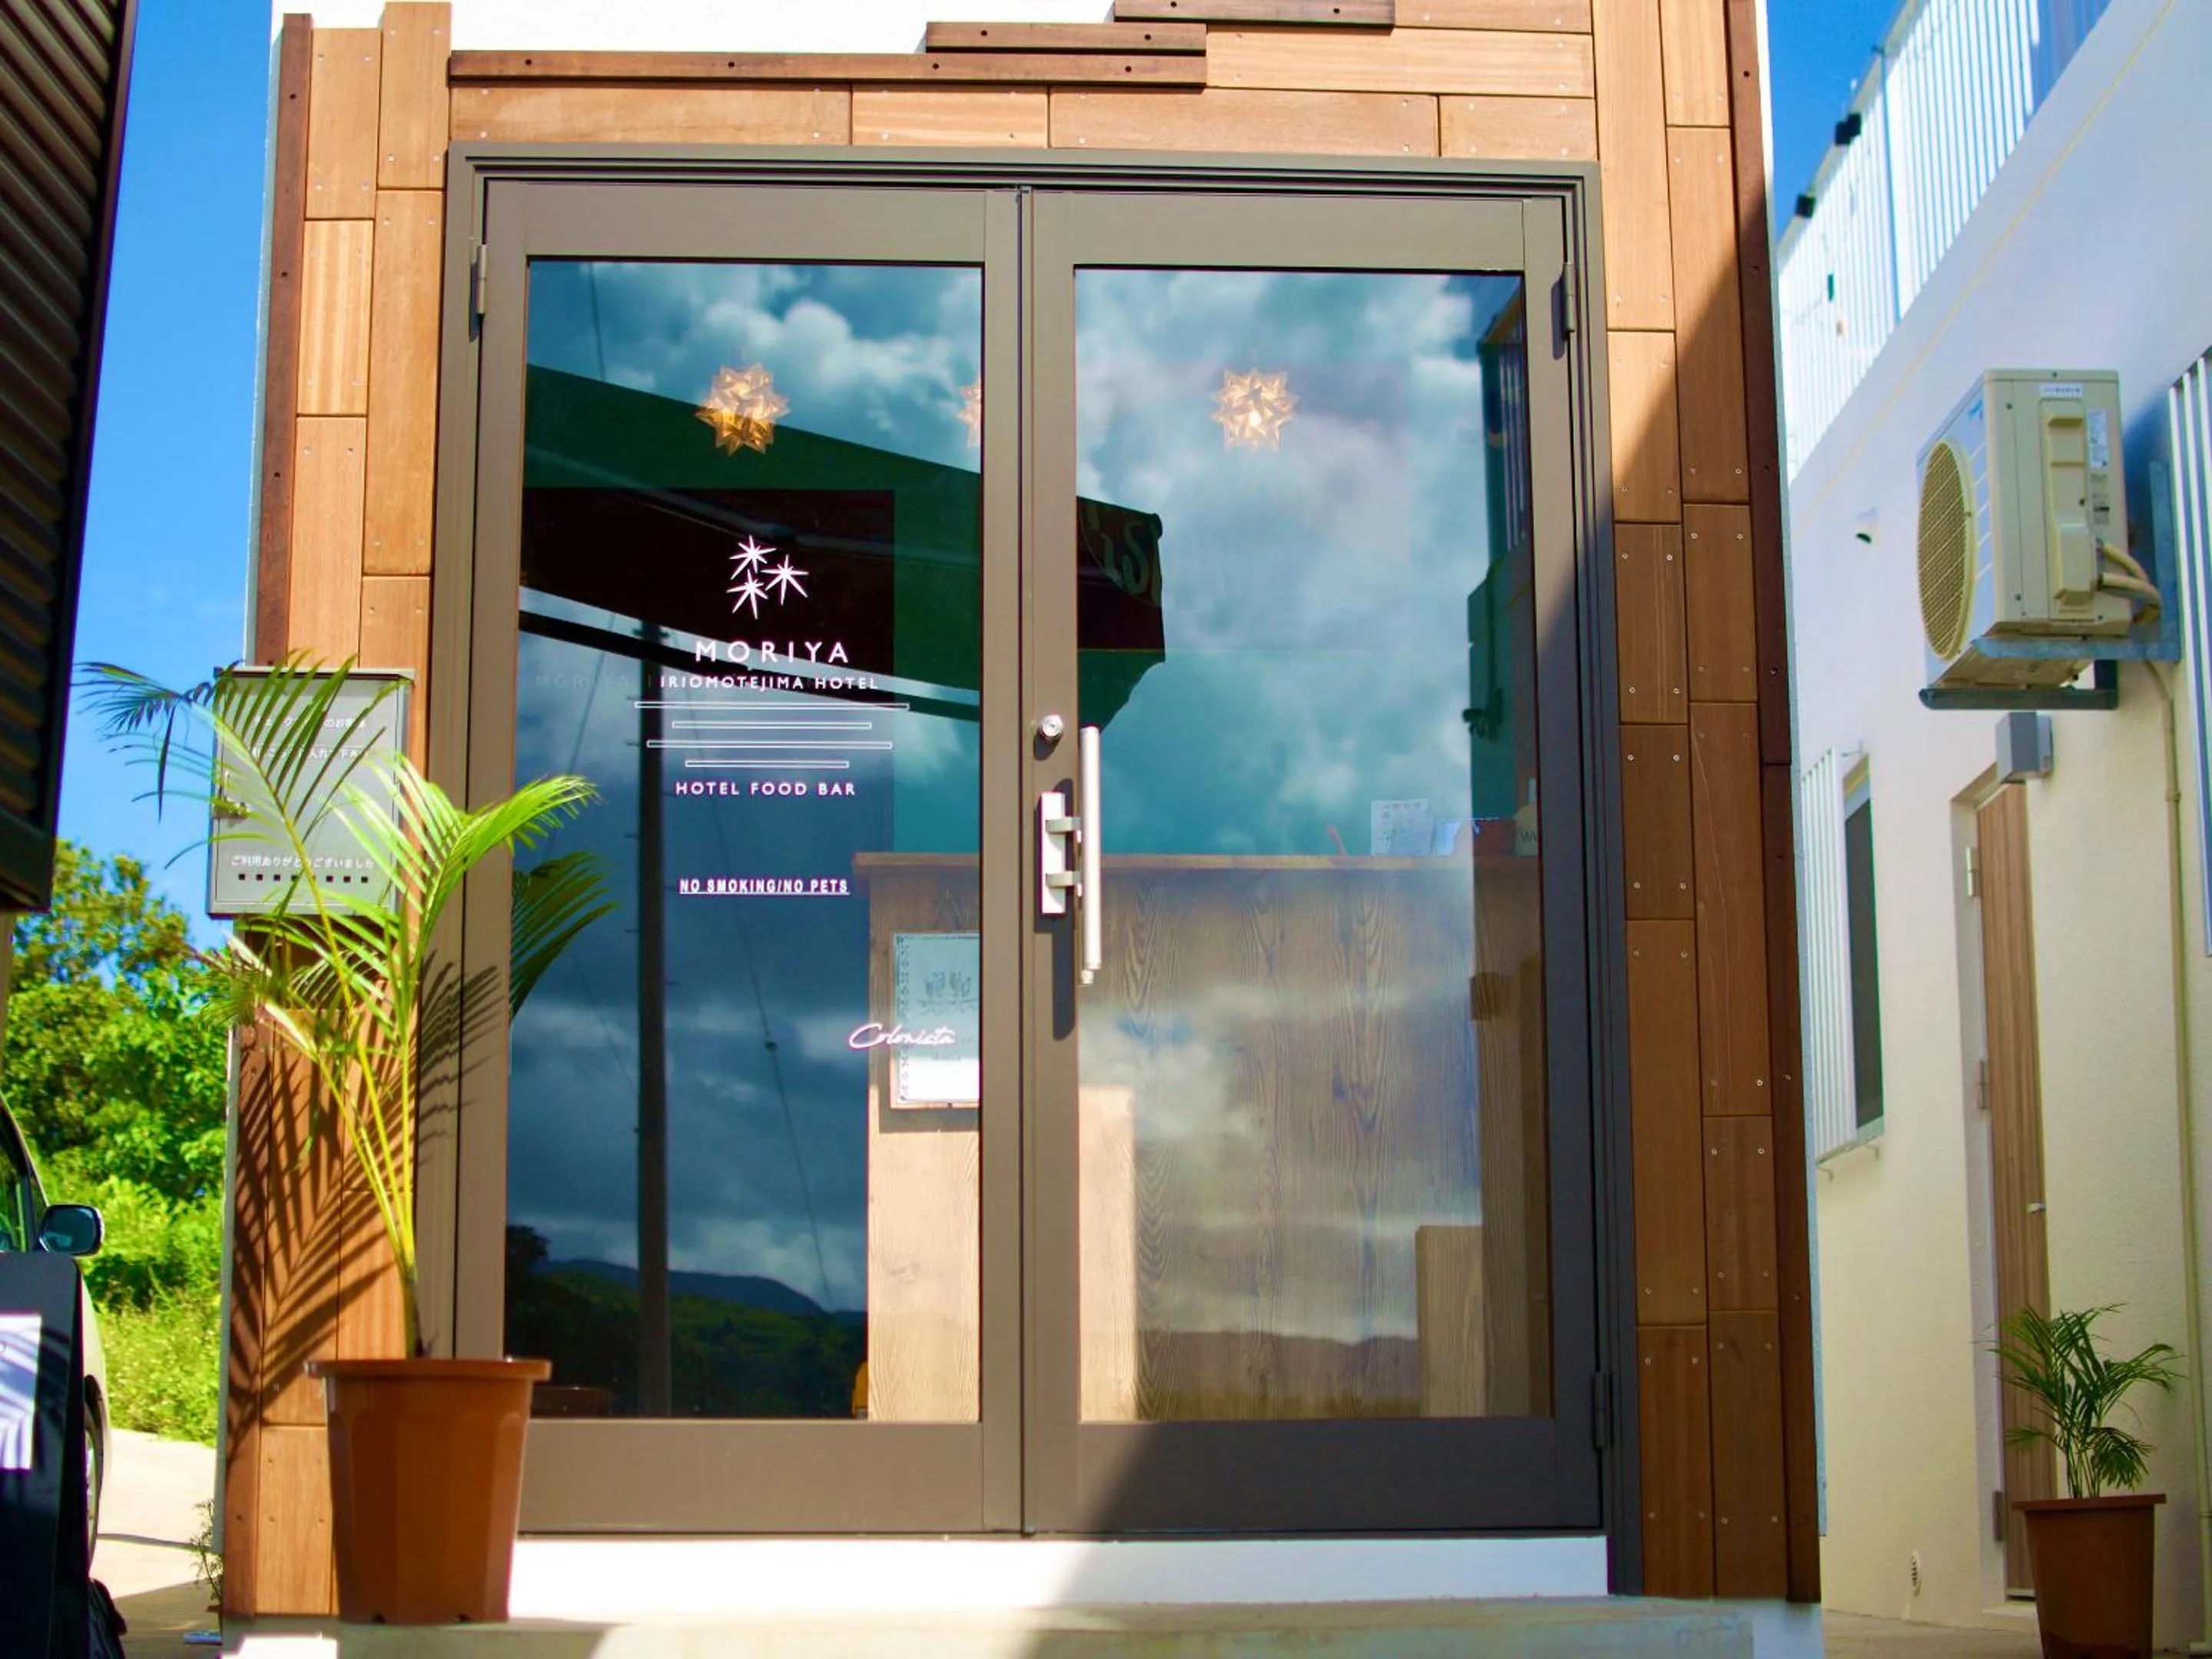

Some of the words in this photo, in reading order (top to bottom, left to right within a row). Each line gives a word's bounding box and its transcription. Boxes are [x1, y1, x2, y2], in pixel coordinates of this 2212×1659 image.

[695, 641, 849, 663] MORIYA
[660, 676, 804, 692] IRIOMOTEJIMA
[814, 677, 879, 690] HOTEL
[675, 781, 740, 796] HOTEL
[750, 781, 807, 796] FOOD
[818, 782, 856, 796] BAR
[230, 853, 376, 869] ご利用ありがとございました
[680, 878, 700, 892] NO
[706, 878, 804, 893] SMOKING/NO
[809, 879, 848, 893] PETS
